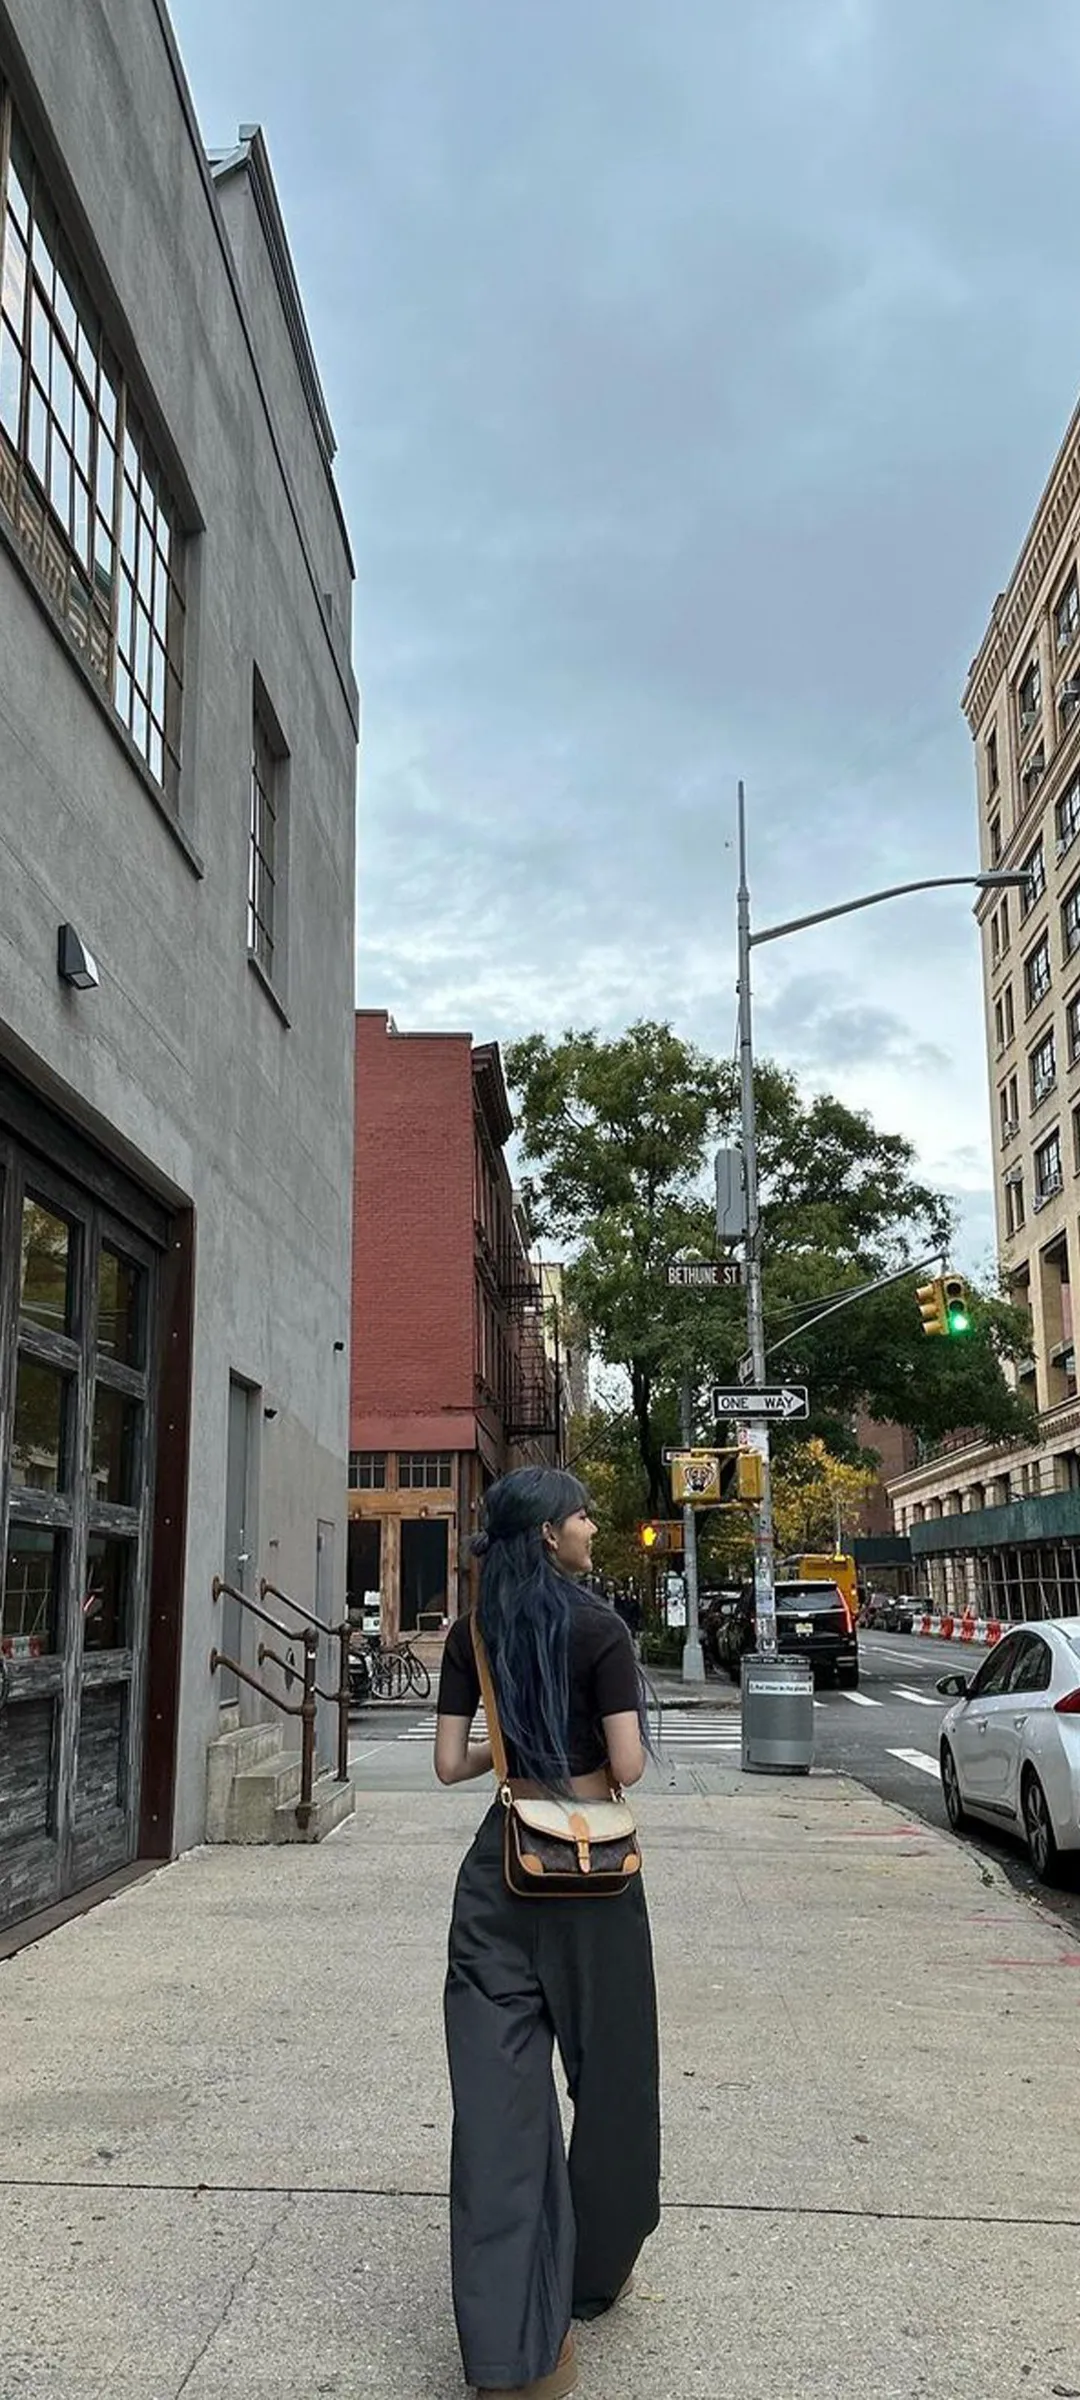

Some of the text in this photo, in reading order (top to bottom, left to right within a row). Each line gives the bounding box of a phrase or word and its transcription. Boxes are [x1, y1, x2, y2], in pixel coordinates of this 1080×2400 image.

[668, 1266, 737, 1284] BETHUNE ST
[721, 1397, 794, 1409] ONE WAY
